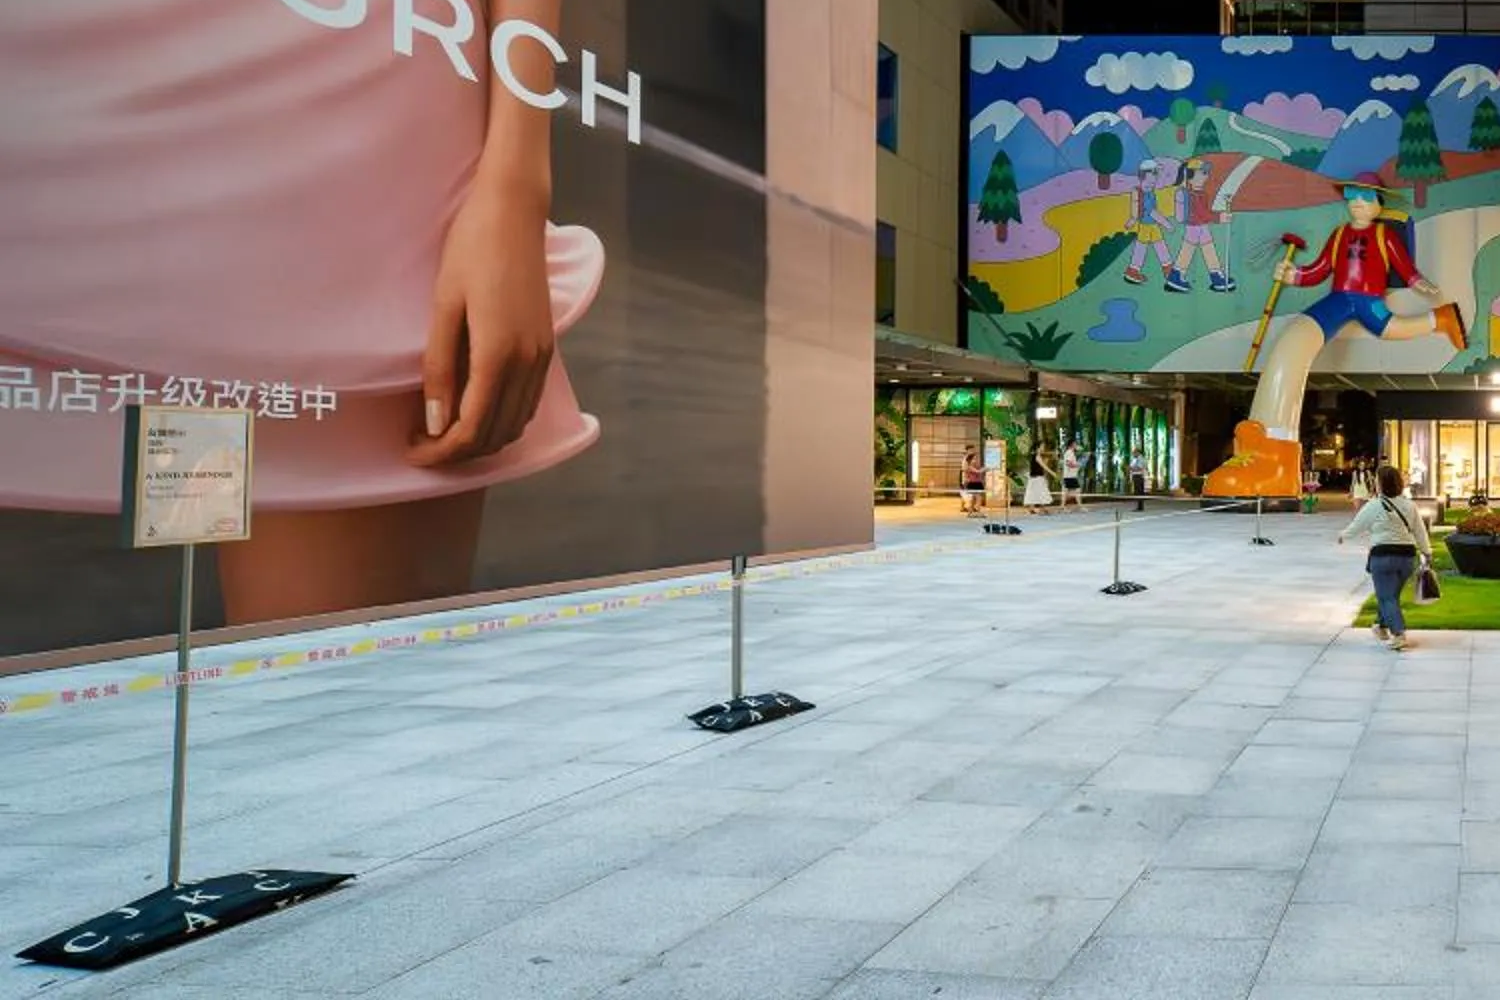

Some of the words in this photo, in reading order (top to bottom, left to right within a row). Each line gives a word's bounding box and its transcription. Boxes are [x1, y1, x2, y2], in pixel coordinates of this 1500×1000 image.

[0, 364, 338, 421] 品店升级改造中
